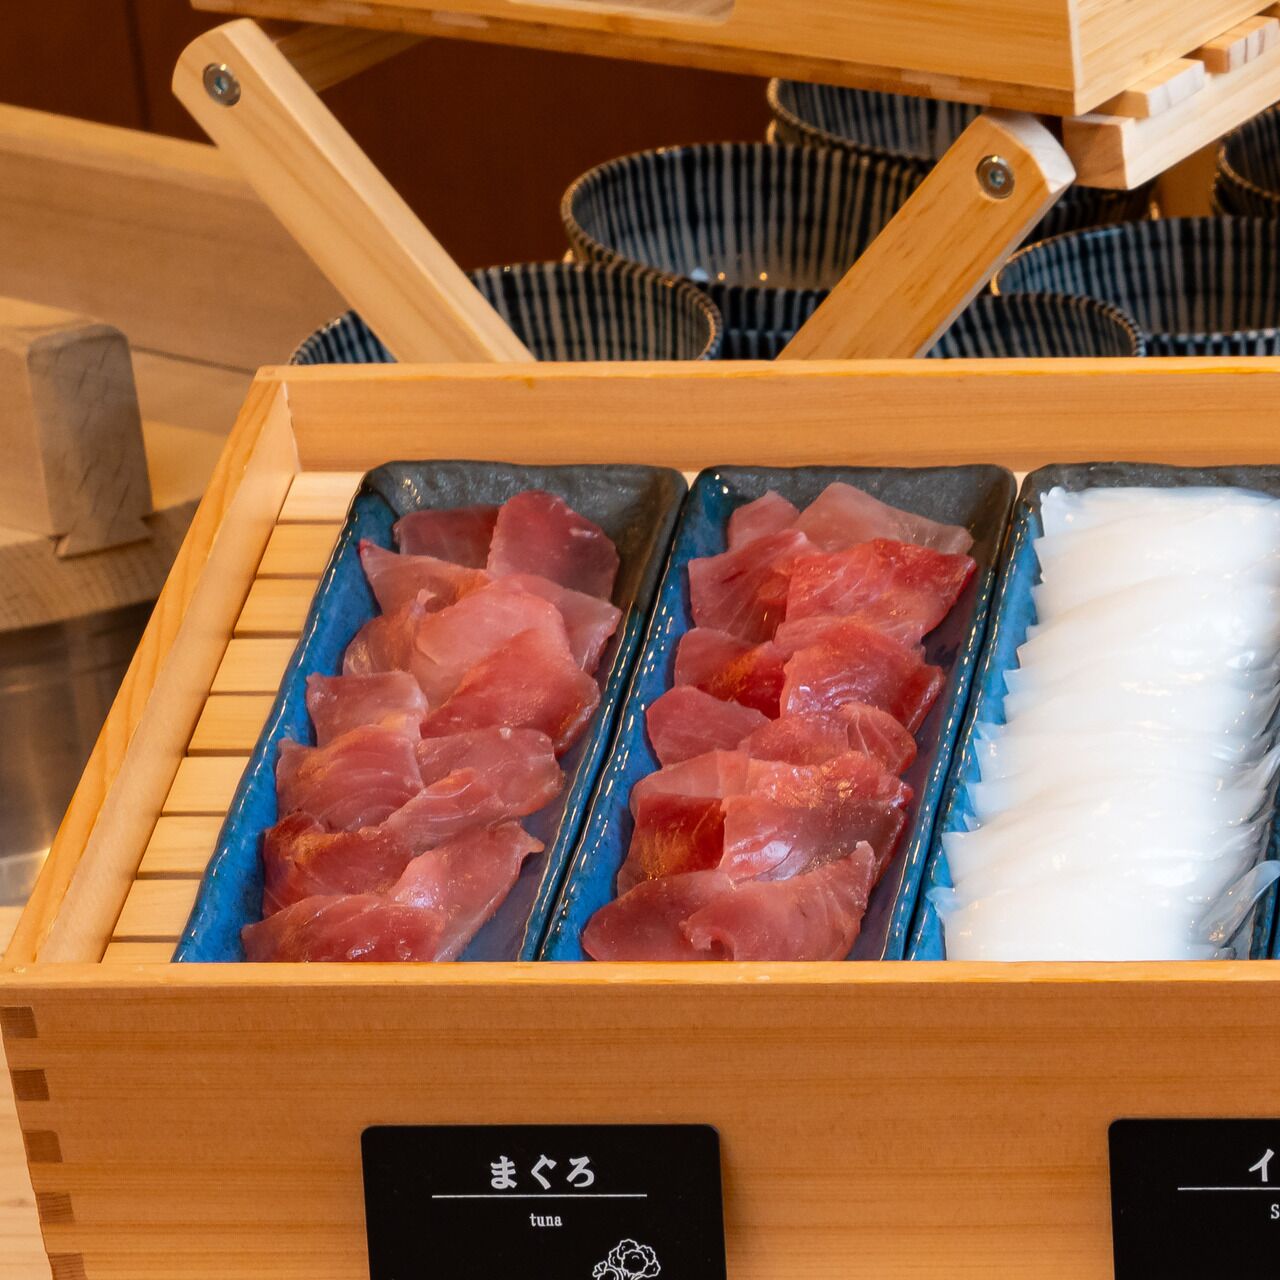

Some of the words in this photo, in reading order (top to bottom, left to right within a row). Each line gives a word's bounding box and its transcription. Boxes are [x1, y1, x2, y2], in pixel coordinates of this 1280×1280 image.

[491, 1155, 596, 1191] まぐろ
[529, 1213, 564, 1228] tuna
